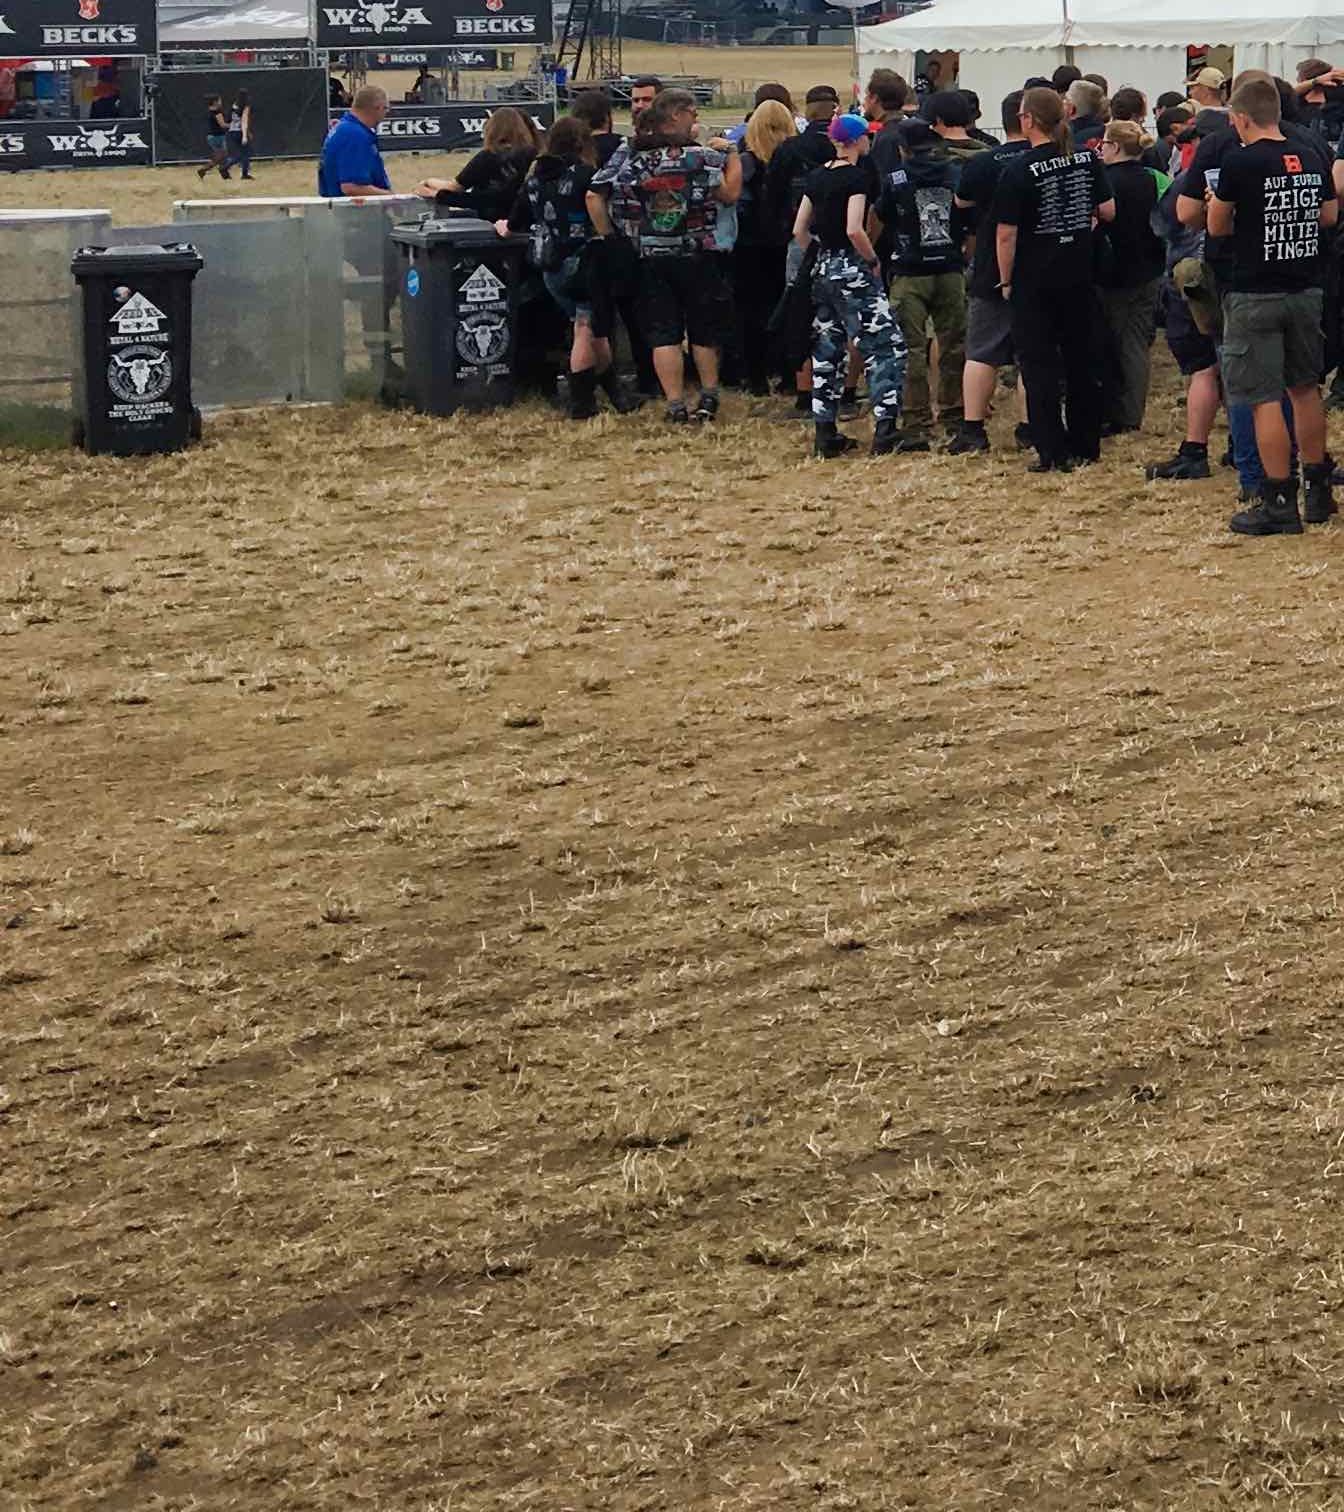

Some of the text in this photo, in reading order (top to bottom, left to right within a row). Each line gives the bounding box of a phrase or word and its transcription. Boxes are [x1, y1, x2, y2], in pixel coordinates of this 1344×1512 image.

[43, 24, 137, 44] BECK'S
[456, 16, 536, 34] BECK'S
[377, 117, 440, 136] ECK'S
[1264, 176, 1288, 190] AUF
[1264, 188, 1322, 211] ZEIGE-
[1264, 210, 1298, 224] FOLGT
[1264, 239, 1319, 261] FINGER
